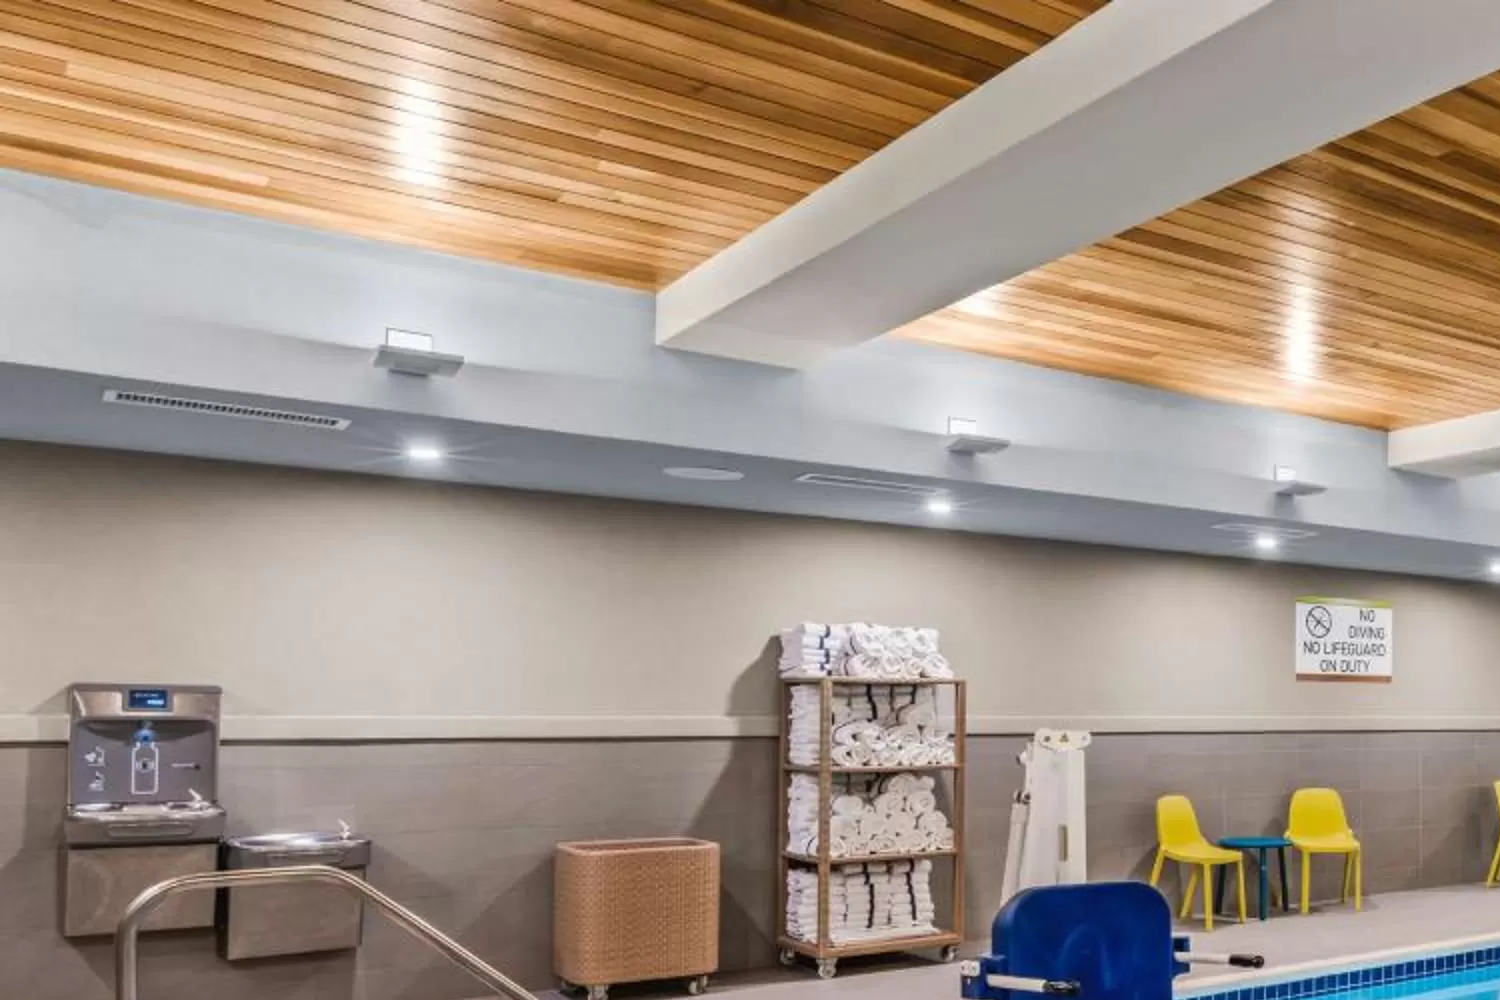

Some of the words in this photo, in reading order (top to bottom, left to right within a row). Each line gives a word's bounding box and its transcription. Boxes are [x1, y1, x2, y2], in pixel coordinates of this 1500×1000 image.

[1359, 609, 1376, 623] NO
[1347, 625, 1385, 640] DIVING
[1303, 641, 1321, 655] NO
[1323, 641, 1386, 657] LIFEGUARD
[1319, 659, 1337, 672] ON
[1339, 659, 1371, 673] DUTY
